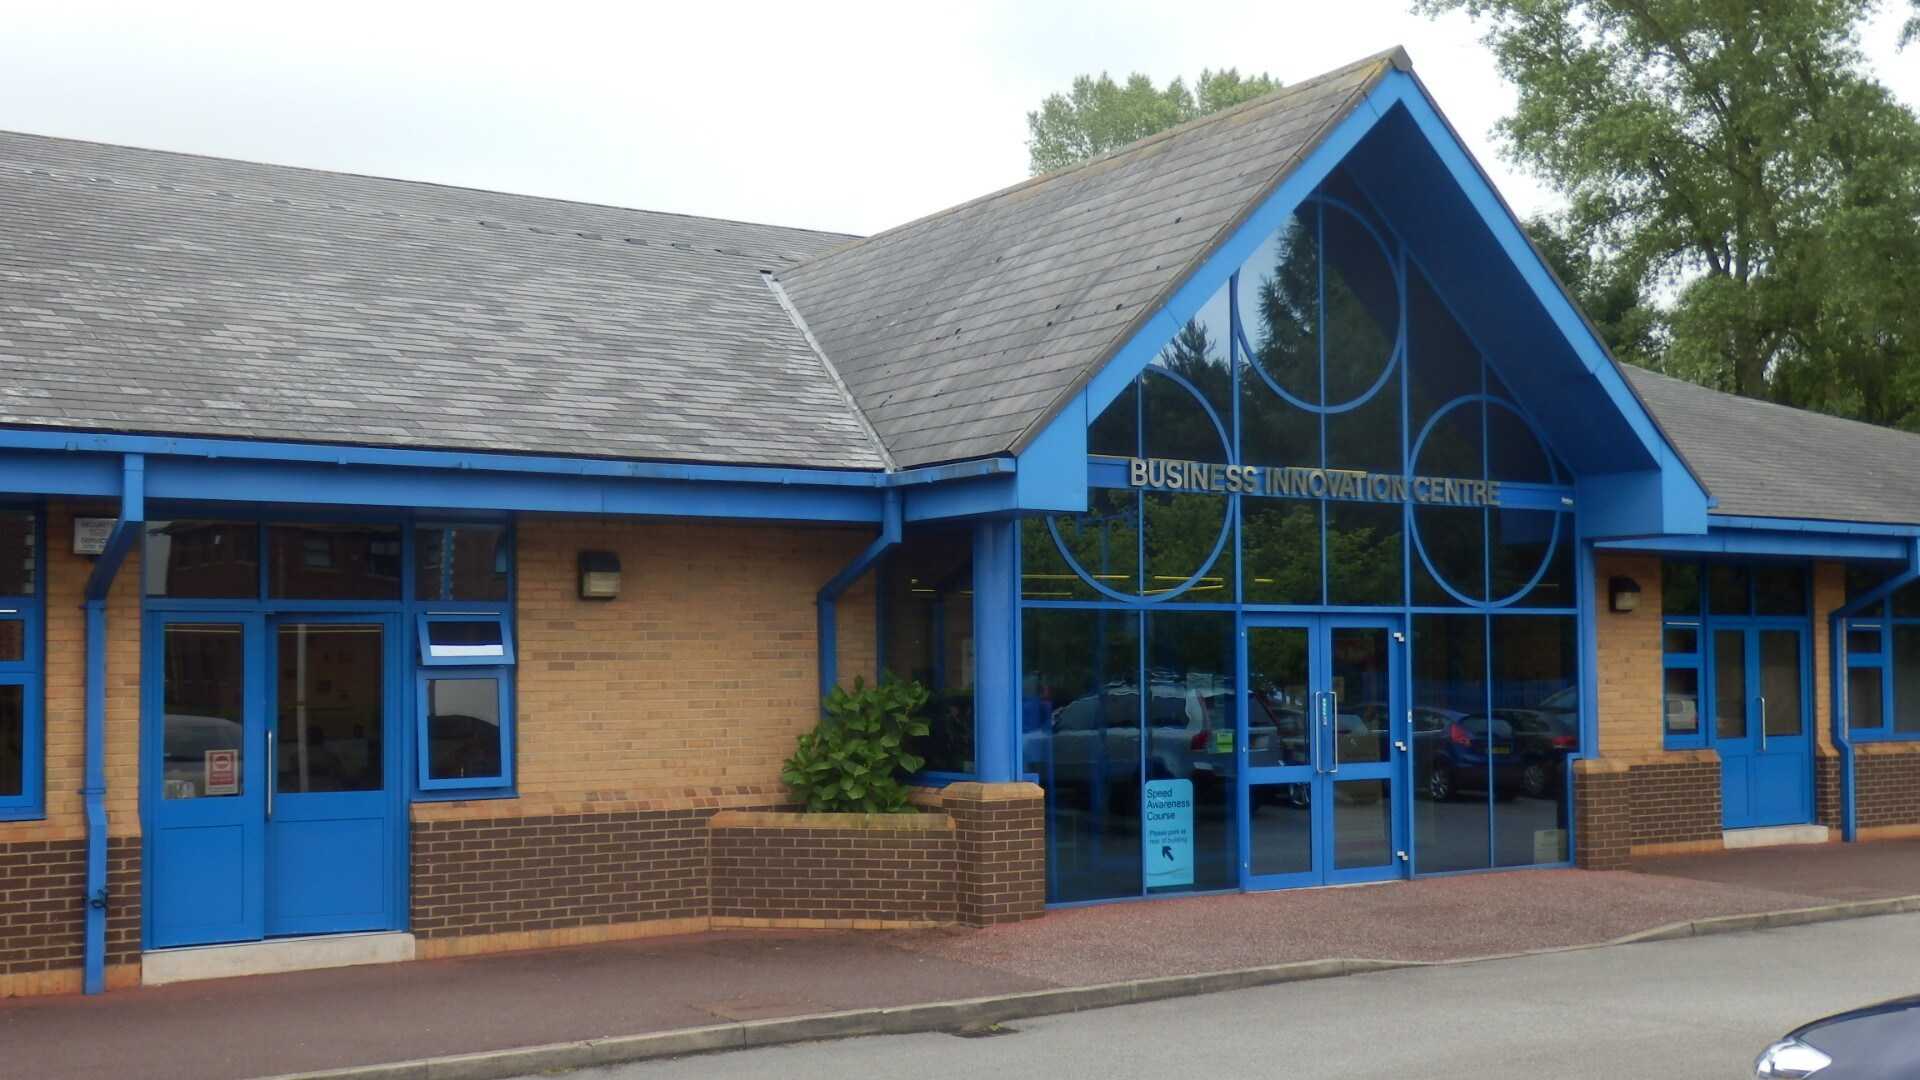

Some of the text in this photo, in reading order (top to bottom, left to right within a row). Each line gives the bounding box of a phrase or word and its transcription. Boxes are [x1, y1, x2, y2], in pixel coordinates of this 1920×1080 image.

[1130, 458, 1501, 506] BUSINESS INNOVATION CENTRE
[1147, 788, 1173, 799] Speed
[1147, 800, 1190, 809] Awareness
[1147, 812, 1176, 821] Course
[1168, 829, 1180, 837] park
[1167, 836, 1188, 844] building
